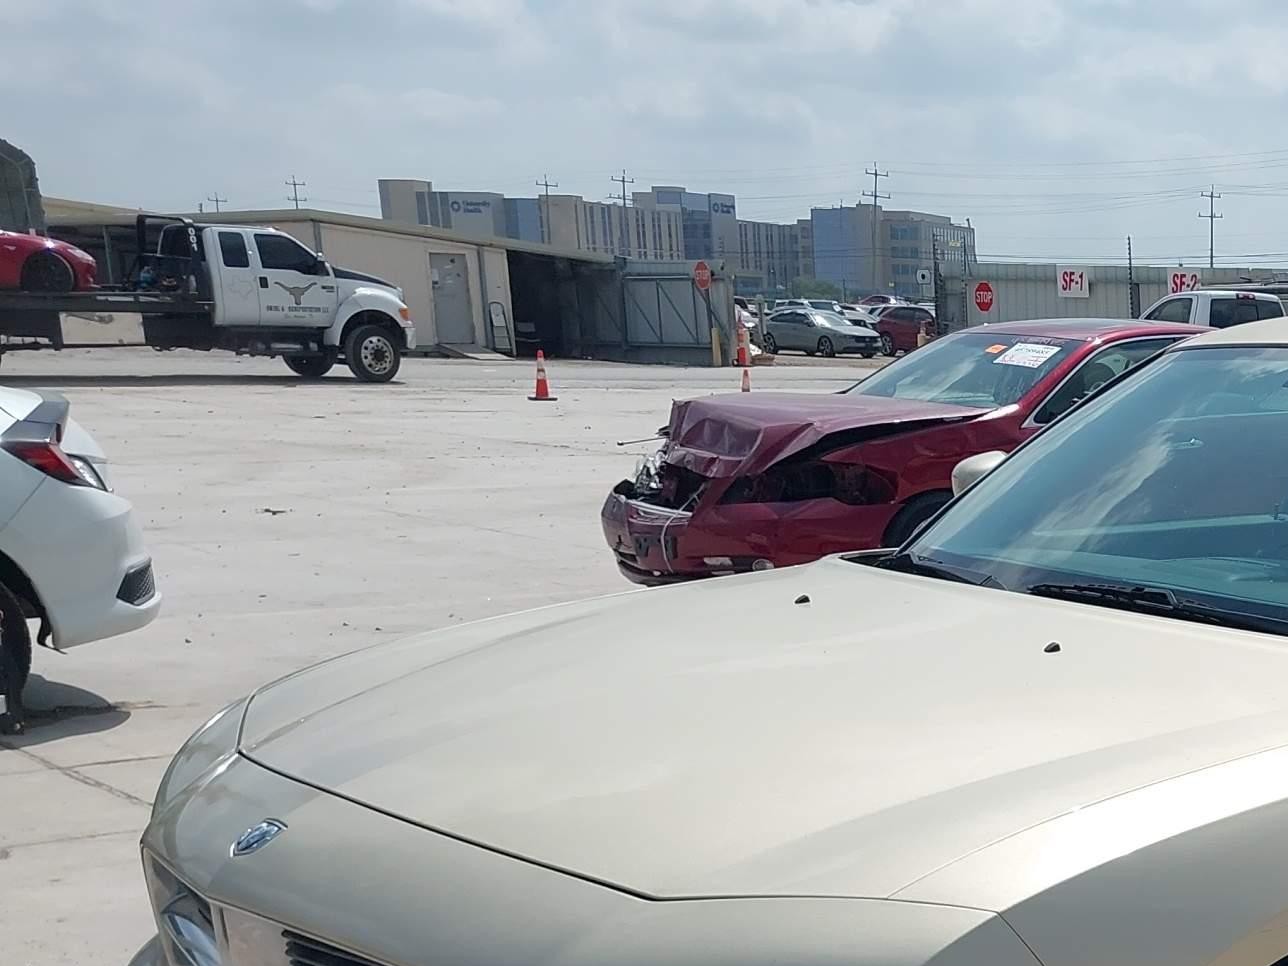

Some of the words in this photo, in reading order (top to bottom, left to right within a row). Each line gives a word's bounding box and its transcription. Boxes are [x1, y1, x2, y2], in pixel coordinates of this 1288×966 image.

[1062, 271, 1084, 291] SF-1
[1171, 273, 1198, 294] SF-2
[976, 291, 993, 303] STOP
